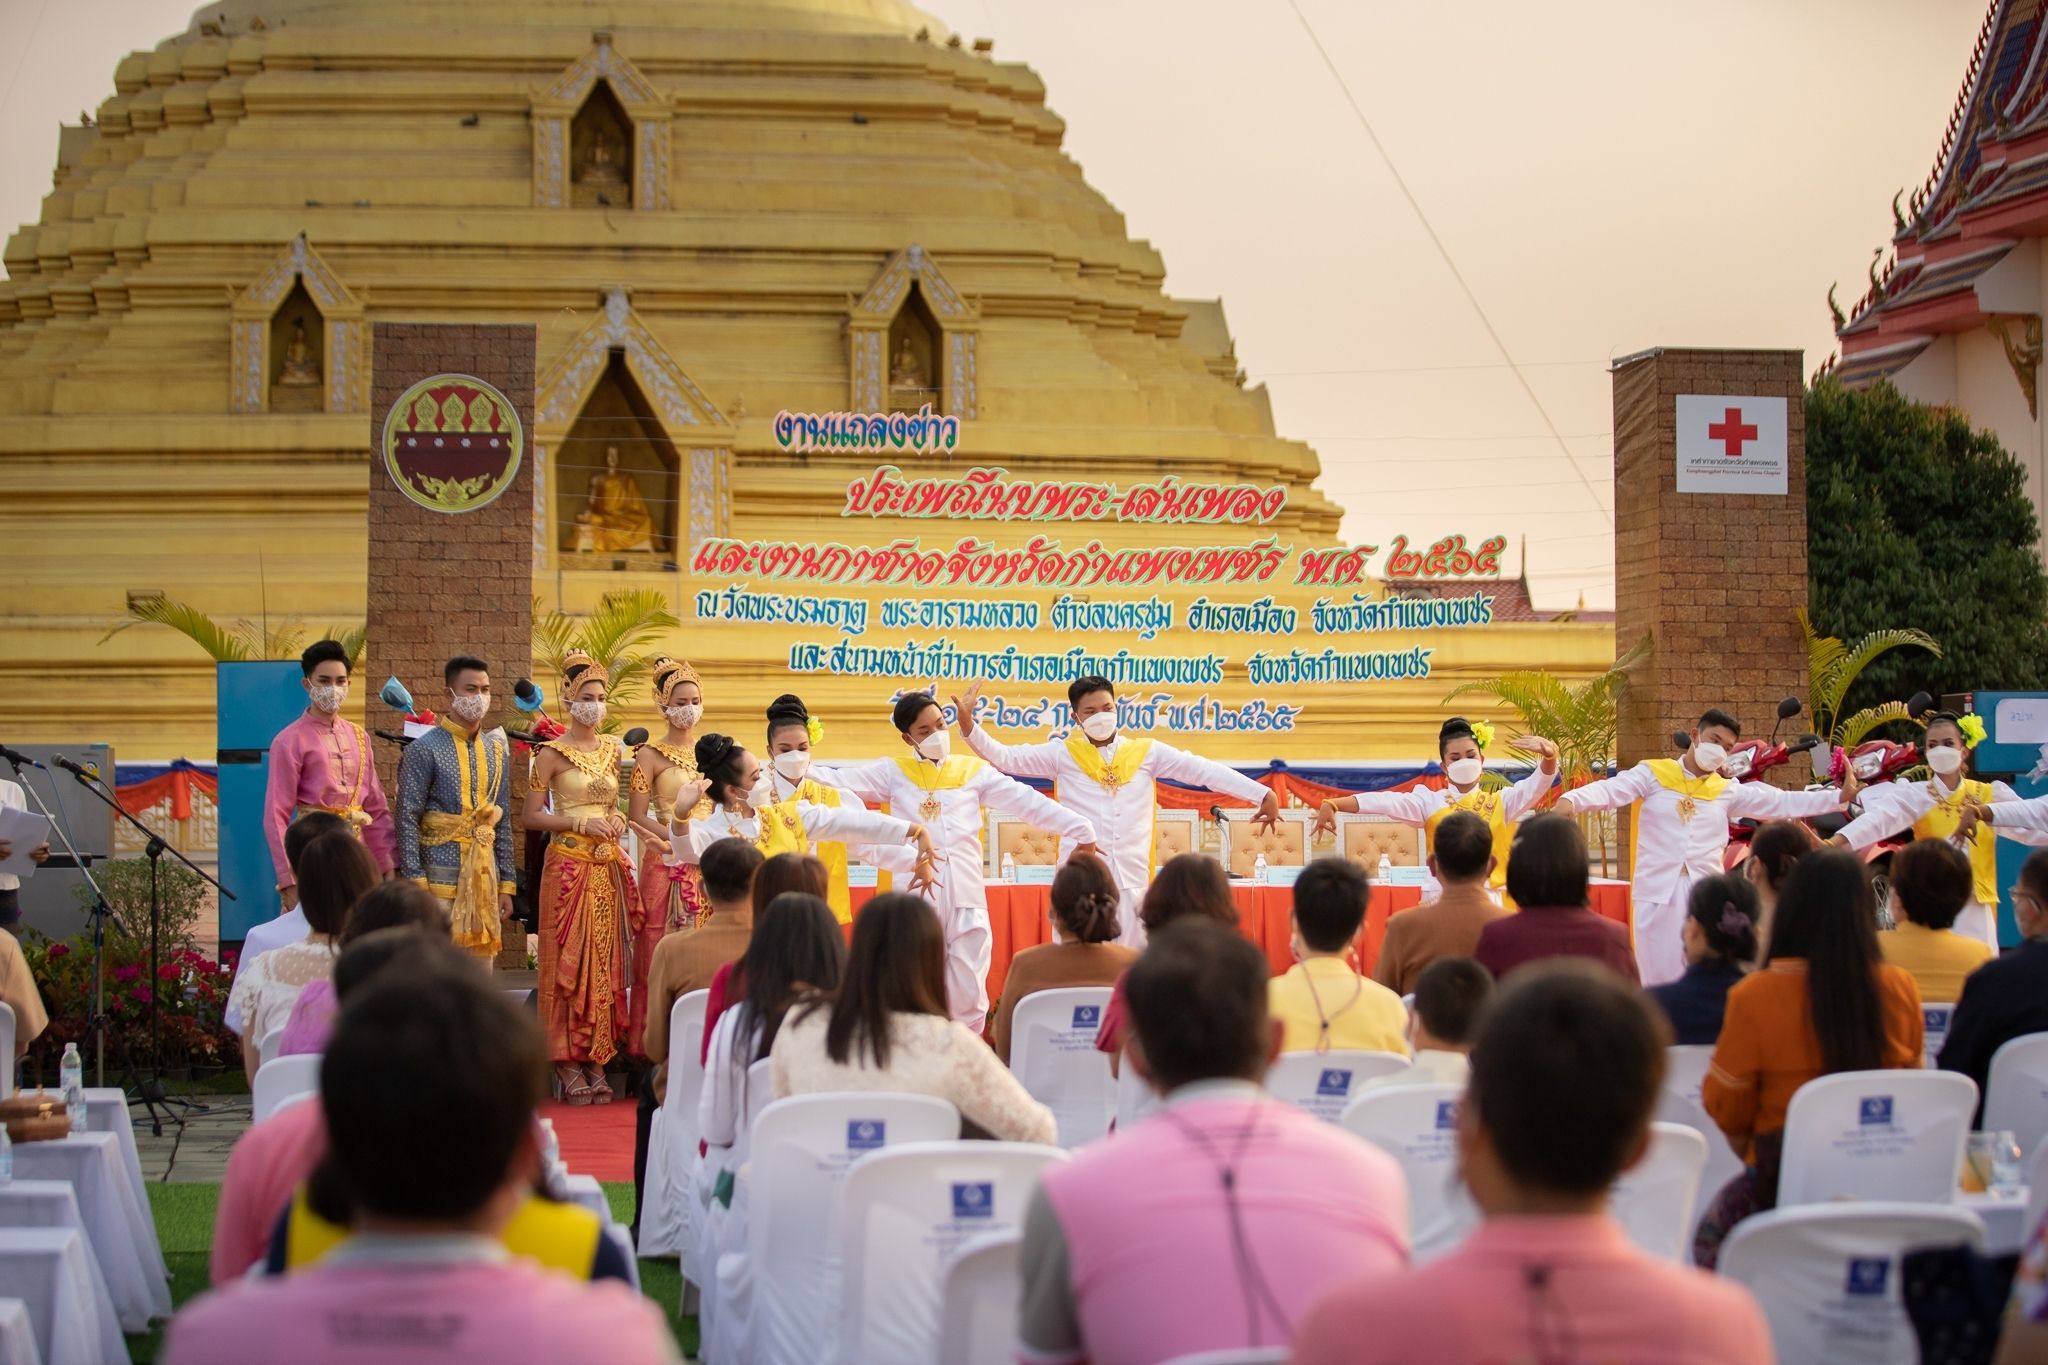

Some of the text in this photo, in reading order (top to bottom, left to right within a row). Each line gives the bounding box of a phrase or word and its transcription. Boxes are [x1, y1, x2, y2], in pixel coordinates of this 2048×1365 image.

[775, 404, 959, 453] งานแถลงข่าว
[692, 536, 1291, 587] และงานกาชาดจังหวัดกำแพงเพชร
[1386, 535, 1506, 578] ๒๕๖๕
[881, 598, 1038, 629] พระอารามหลวง
[1051, 595, 1172, 640] ตำบลนครชุม
[1187, 597, 1296, 634] อำเภอเมือง
[1311, 591, 1493, 634] จังหวัดกำแพงเพชร
[1248, 645, 1433, 685] จังหวัดกำแพงเพชร
